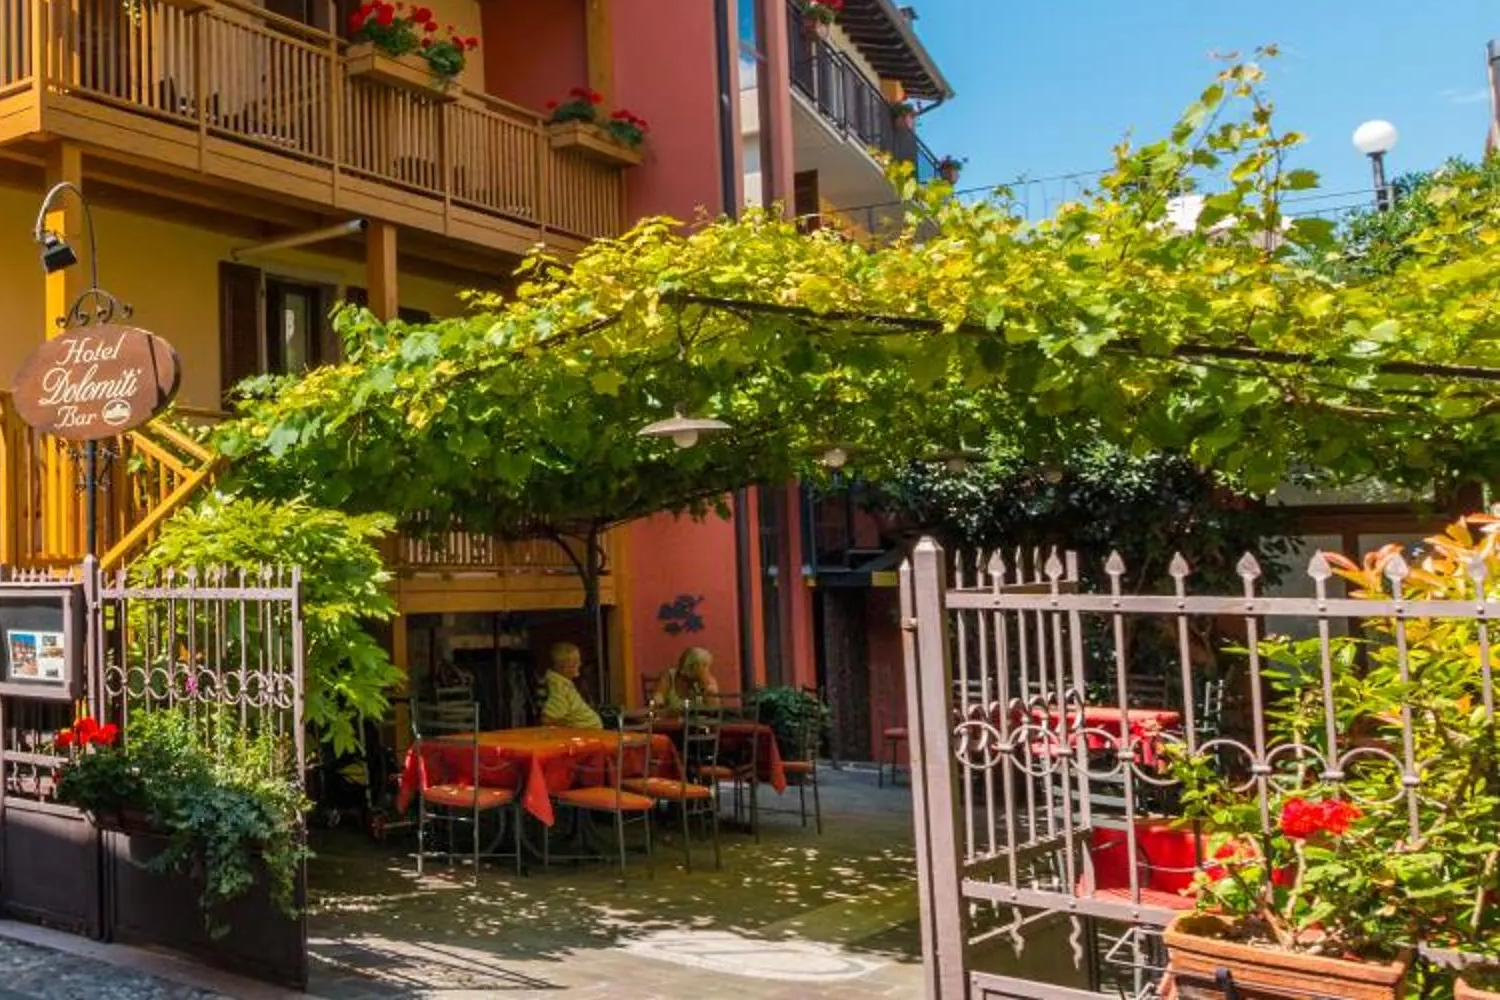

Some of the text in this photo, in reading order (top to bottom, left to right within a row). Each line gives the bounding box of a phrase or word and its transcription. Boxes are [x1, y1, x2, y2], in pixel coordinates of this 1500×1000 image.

[55, 331, 126, 365] Hotel
[39, 364, 142, 406] Dolomiti
[53, 404, 98, 428] Bar
